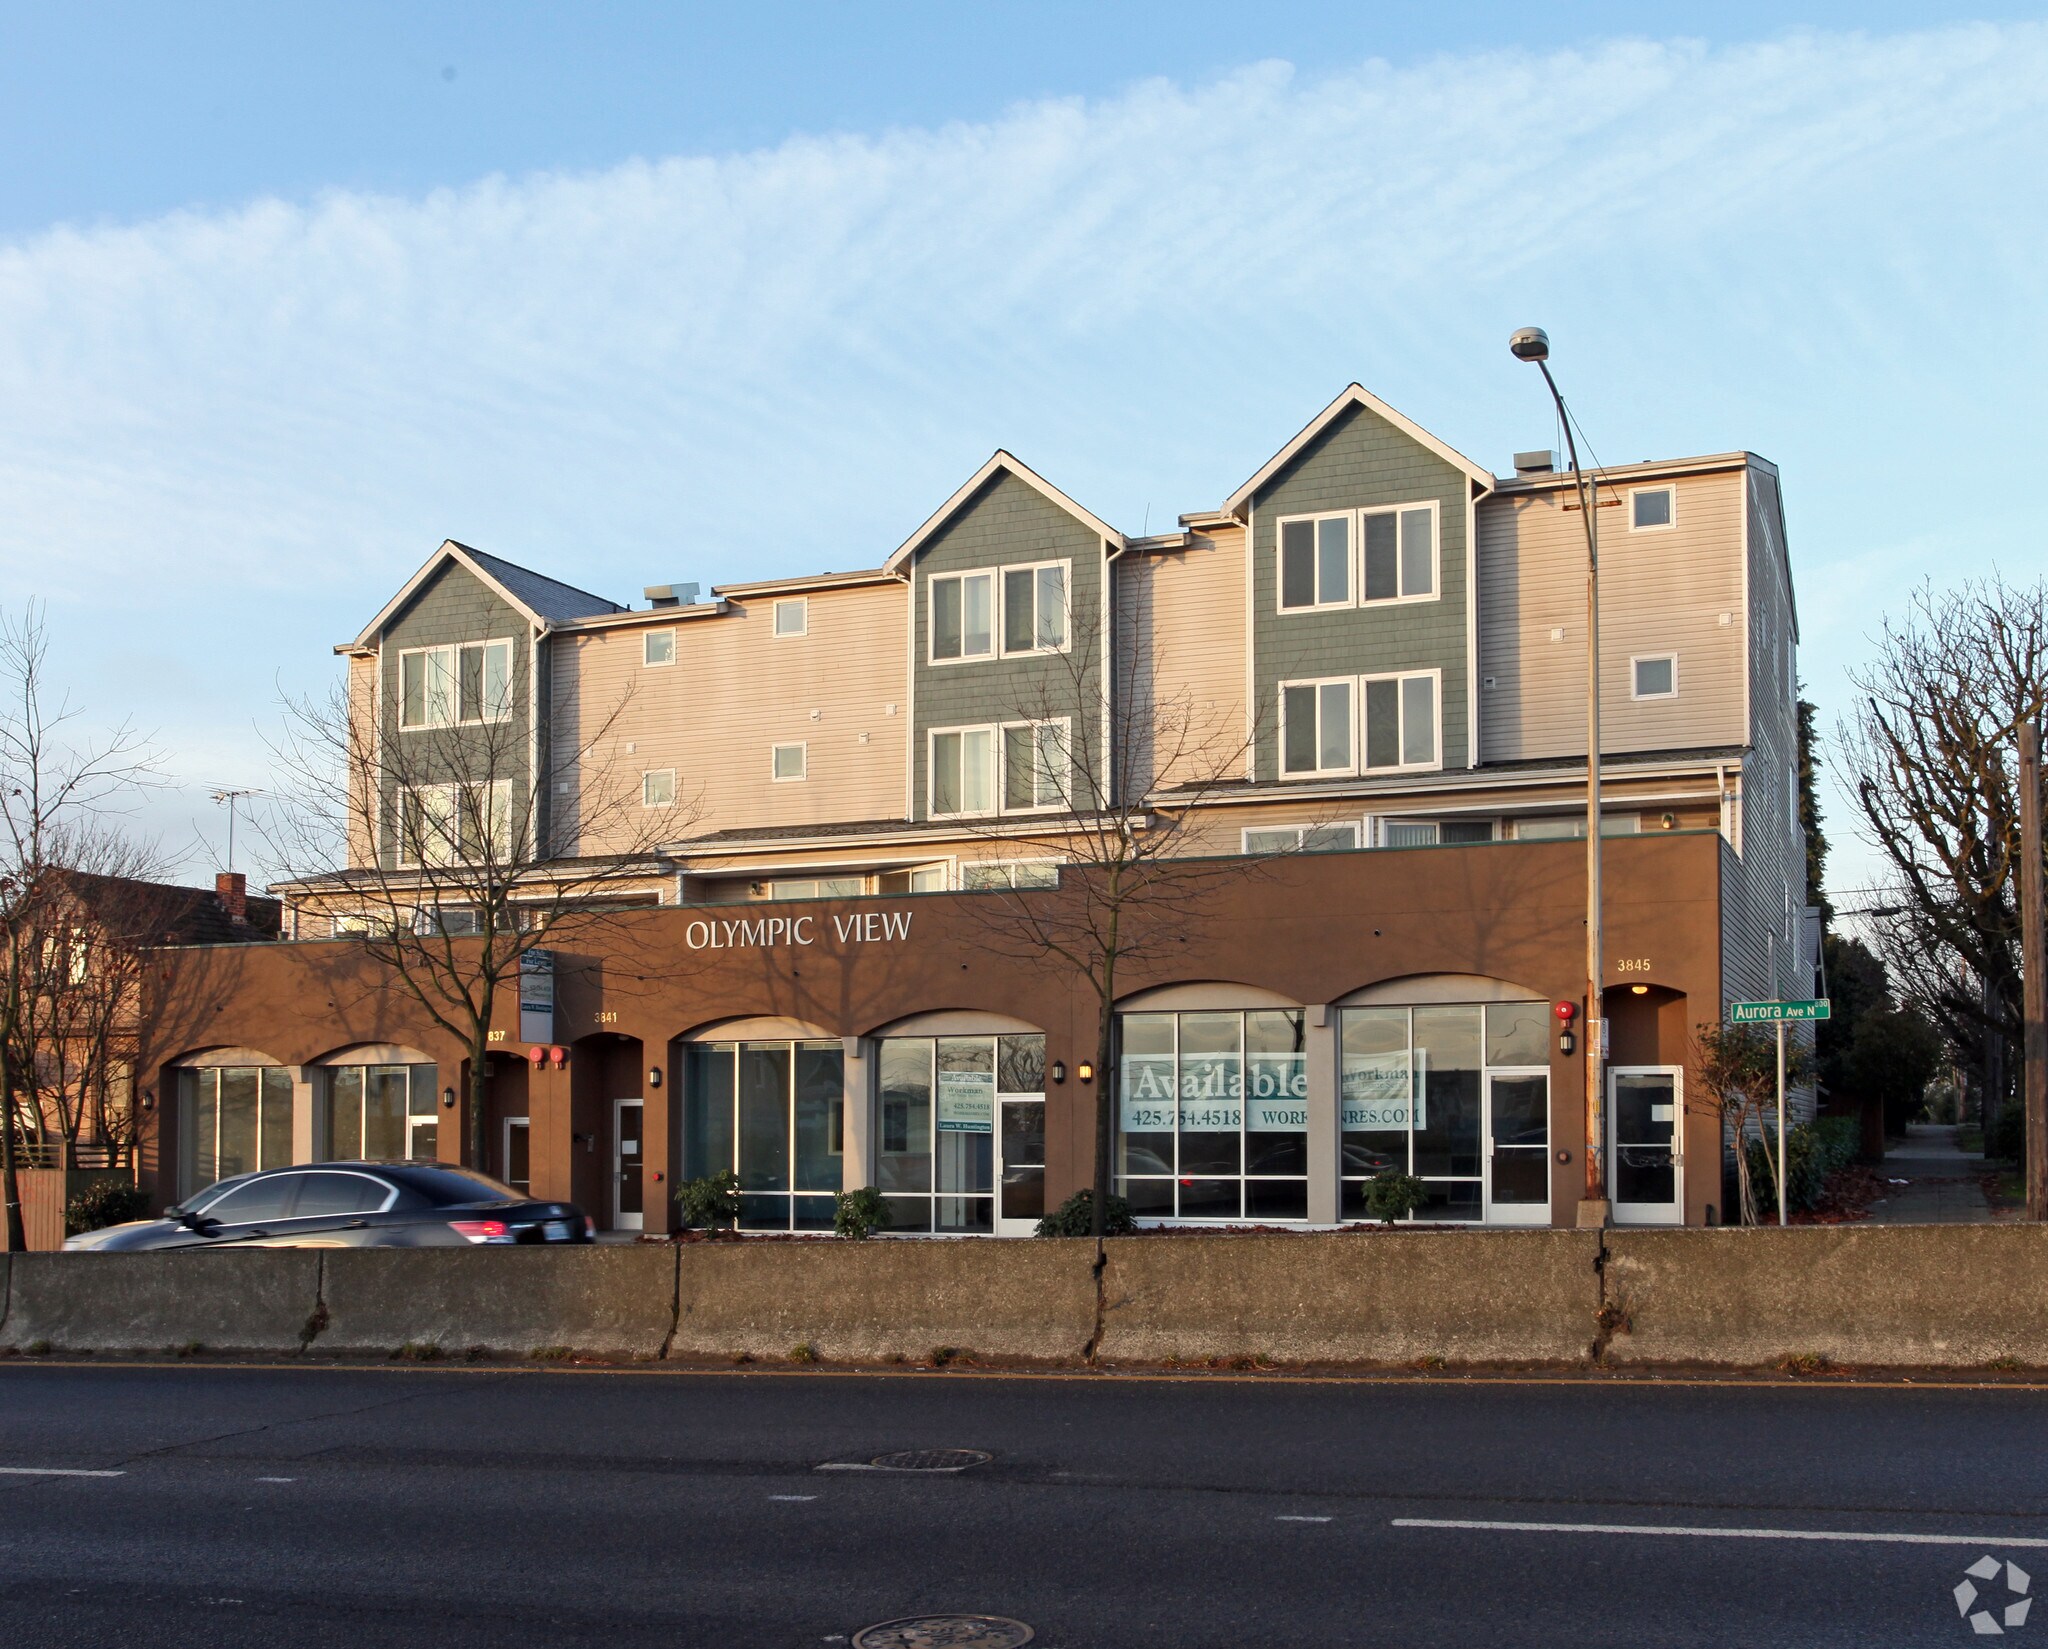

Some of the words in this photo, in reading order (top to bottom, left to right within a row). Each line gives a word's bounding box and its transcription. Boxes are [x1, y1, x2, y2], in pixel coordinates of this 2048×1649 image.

[685, 916, 815, 950] OLYMPIC
[833, 911, 913, 943] VIEW
[1617, 958, 1651, 972] 3845
[594, 1012, 617, 1023] 3841
[1735, 1004, 1782, 1020] Aurora
[1786, 1007, 1804, 1017] Ave
[1807, 1005, 1815, 1016] N
[487, 1031, 506, 1042] 837
[1133, 1063, 1307, 1098] Available
[948, 1086, 983, 1094] Workman
[1132, 1109, 1242, 1126] 425.754.4518
